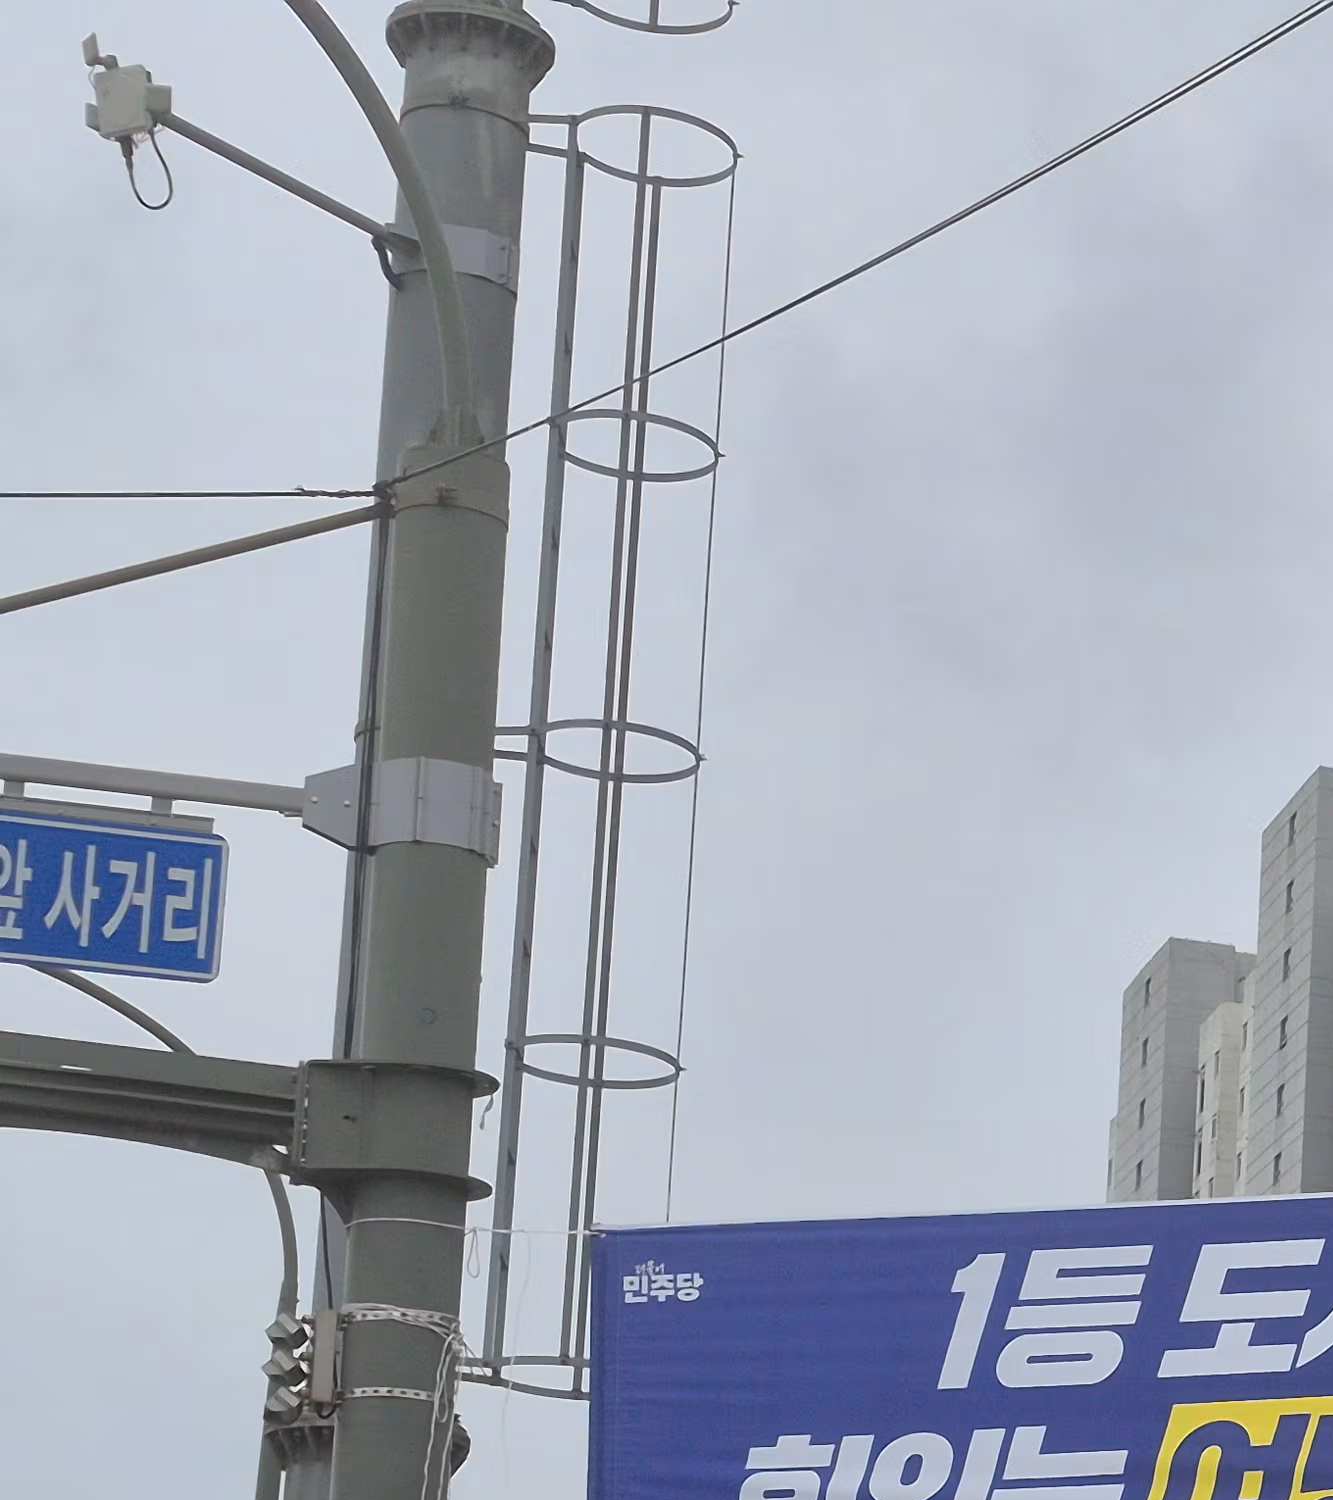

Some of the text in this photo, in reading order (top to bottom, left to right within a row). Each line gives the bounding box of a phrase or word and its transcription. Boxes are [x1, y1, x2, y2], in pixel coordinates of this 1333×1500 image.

[44, 845, 213, 959] 사거리
[623, 1273, 704, 1303] 민주당
[936, 1245, 1153, 1390] 1등
